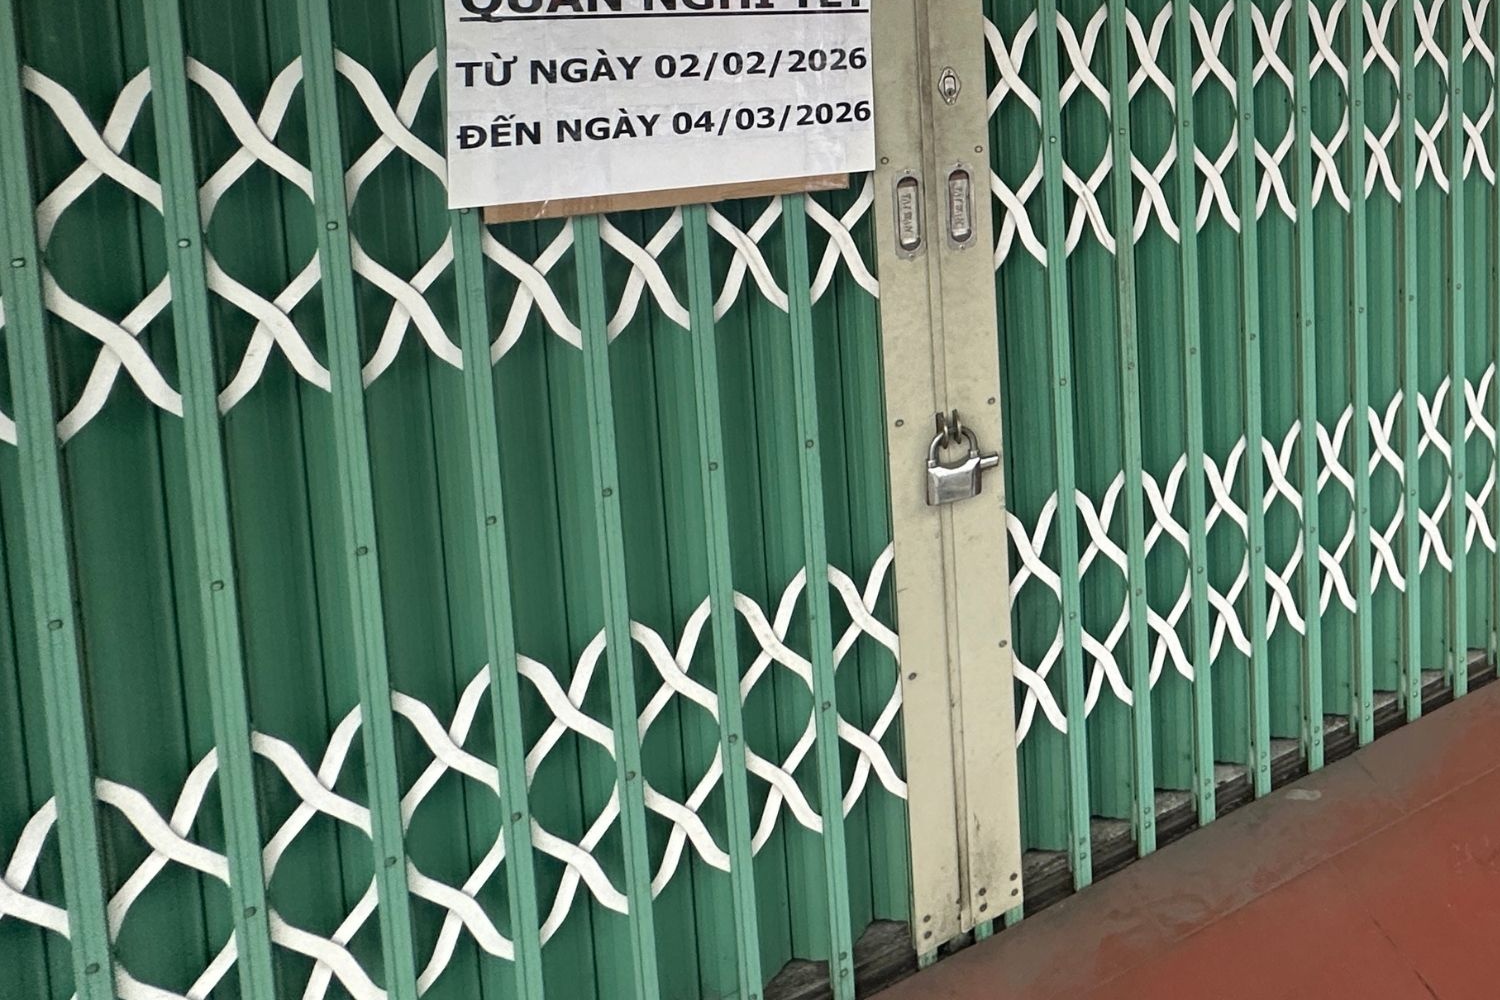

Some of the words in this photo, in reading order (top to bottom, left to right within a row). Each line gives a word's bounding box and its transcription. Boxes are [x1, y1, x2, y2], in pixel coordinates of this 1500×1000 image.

[455, 52, 518, 87] TỪ
[530, 48, 643, 85] NGÀY
[655, 47, 867, 82] 02/02/2026
[456, 114, 541, 150] ĐẾN
[557, 106, 661, 144] NGÀY
[672, 100, 872, 135] 04/03/2026
